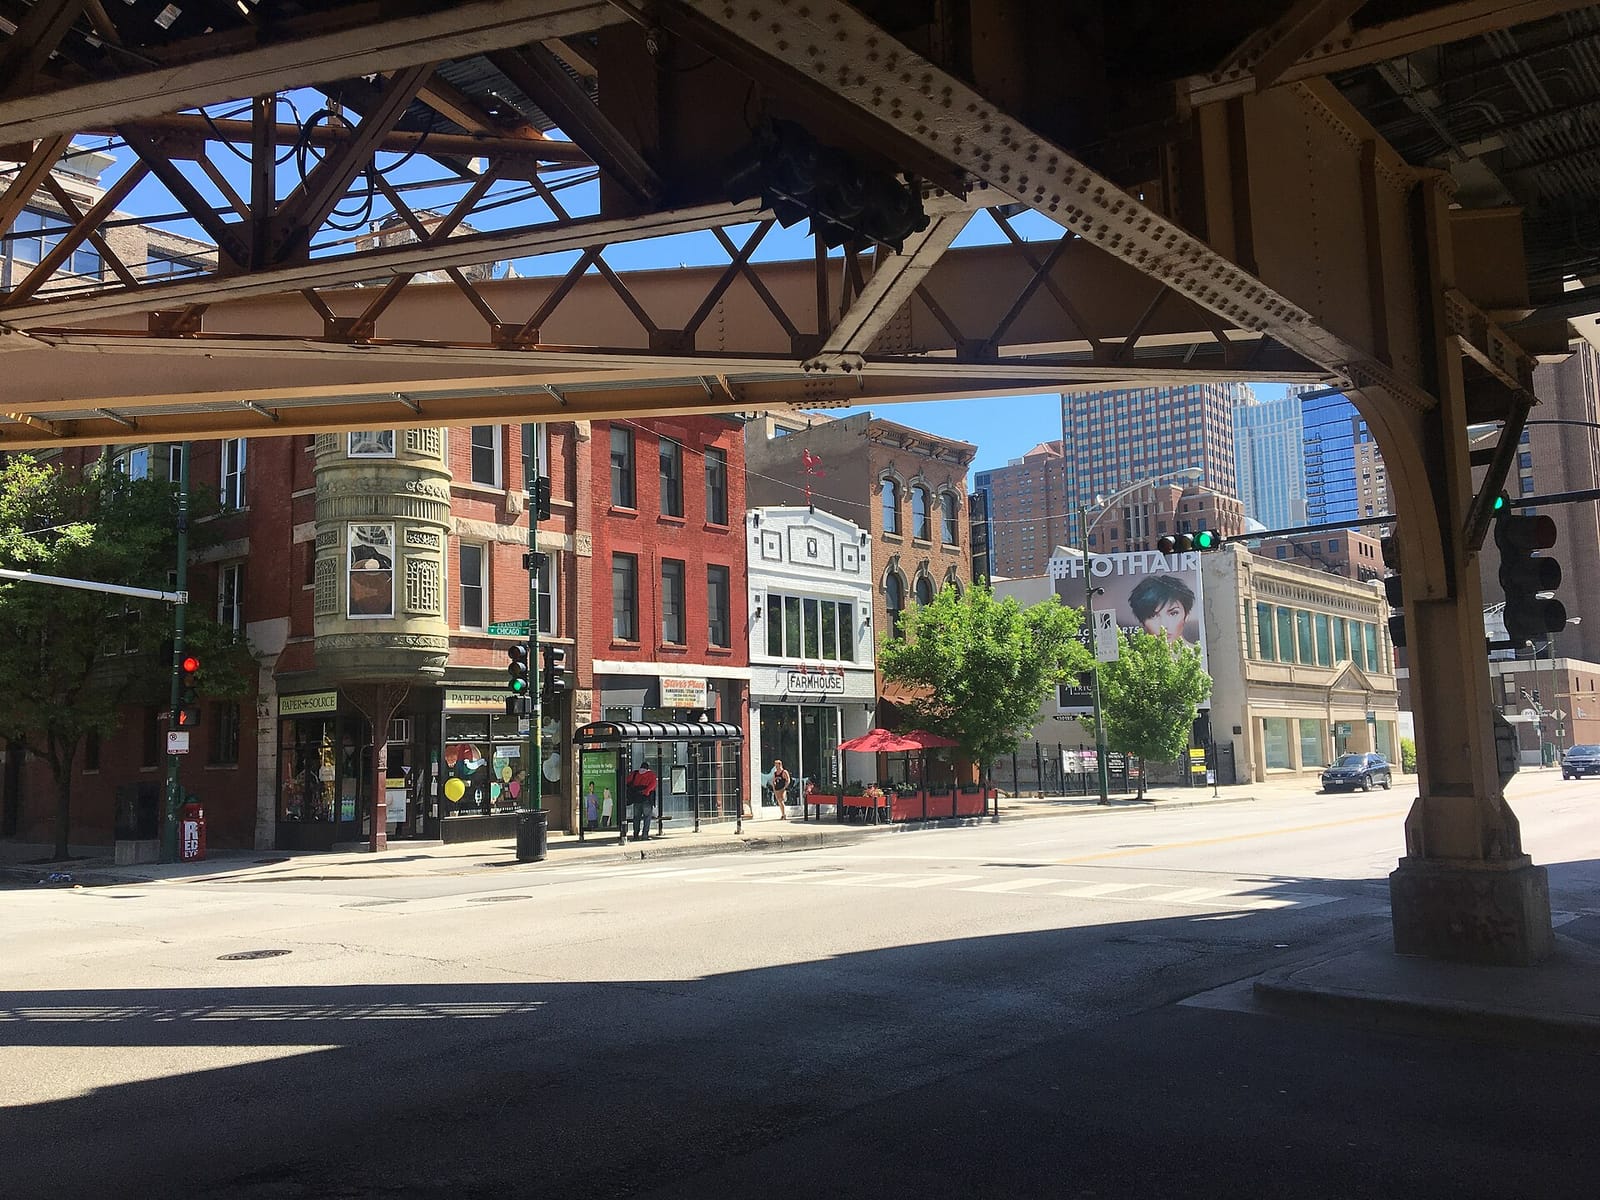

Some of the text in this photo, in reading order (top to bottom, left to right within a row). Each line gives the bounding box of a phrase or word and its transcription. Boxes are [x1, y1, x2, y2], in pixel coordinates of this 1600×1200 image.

[1051, 550, 1197, 579] #HOTHAIR
[790, 675, 842, 689] FARMHOUSE
[282, 696, 335, 710] PAPER SOURCE
[451, 694, 481, 704] PAPER
